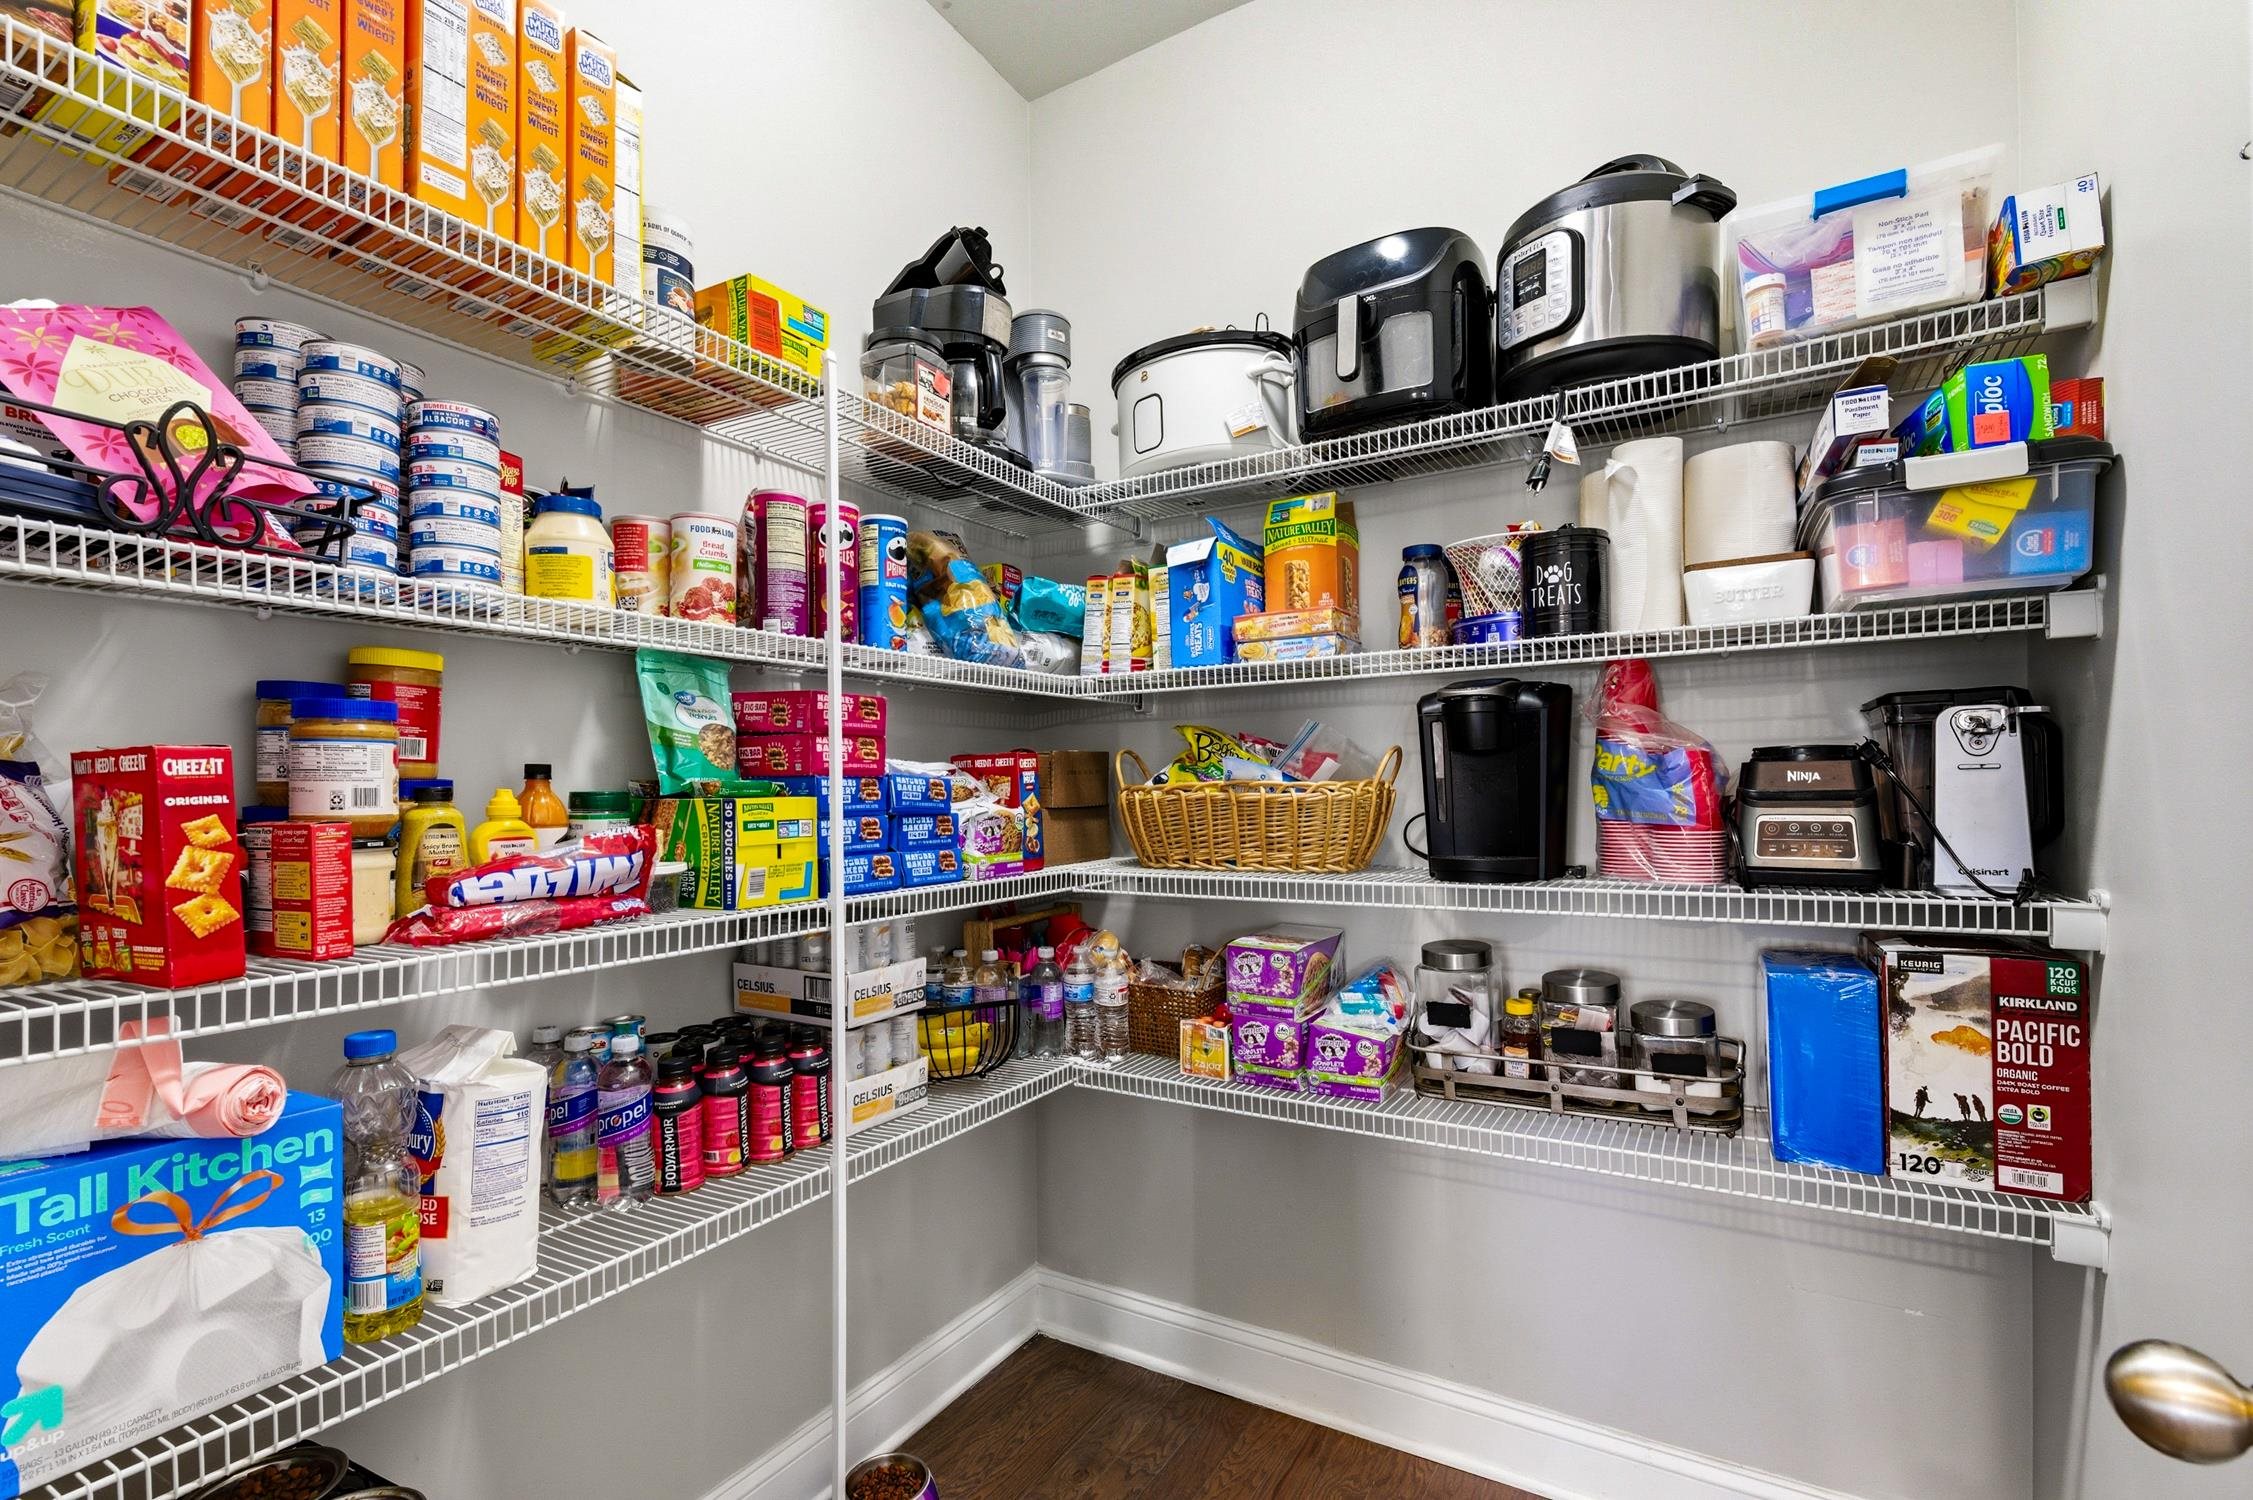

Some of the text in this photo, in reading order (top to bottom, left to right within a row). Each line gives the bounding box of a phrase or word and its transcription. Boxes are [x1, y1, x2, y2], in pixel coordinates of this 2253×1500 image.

[528, 16, 559, 40] Mini
[581, 54, 609, 75] Mini
[2078, 180, 2087, 192] 40
[1841, 398, 1858, 406] FOOD
[424, 415, 470, 428] ALBACORE
[504, 474, 518, 487] Top
[690, 525, 711, 533] FOOD
[1266, 519, 1334, 544] NATURE VALLEY
[703, 540, 724, 550] Bread
[1222, 549, 1235, 567] 40
[1531, 583, 1582, 608] TREATS
[1712, 583, 1786, 605] BUTTER
[1787, 769, 1821, 782] NINJA
[902, 823, 934, 832] BAKERY
[725, 802, 733, 881] 30 POUCHES
[701, 823, 709, 882] CRUNCHY
[706, 803, 720, 904] NATURE VALLEY
[1900, 959, 1940, 969] KEURIG
[2049, 967, 2077, 979] 120
[737, 978, 776, 994] CELSIUS
[854, 983, 892, 1001] CELSIUS
[2050, 986, 2077, 994] PODS
[1998, 996, 2078, 1012] KIRKLAND
[1996, 1019, 2080, 1047] PACIFIC
[1997, 1041, 2054, 1067] BOLD
[1996, 1067, 2038, 1081] ORGANIC
[853, 1084, 893, 1106] CELSIUS
[1996, 1086, 2041, 1096] EXTRA BOLD
[2041, 1084, 2070, 1092] COFFEE
[598, 1099, 647, 1136] propel
[664, 1118, 677, 1187] BODYARMOR
[1900, 1153, 1941, 1175] 120
[0, 1127, 334, 1236] Tall Kitchen
[308, 1207, 325, 1224] 13
[0, 1223, 91, 1257] Fresh Scent
[310, 1228, 332, 1244] 00
[28, 1250, 53, 1262] strong
[53, 1247, 68, 1255] and
[97, 1235, 107, 1243] for
[24, 1261, 39, 1269] and
[65, 1434, 98, 1453] GALLON
[125, 1408, 163, 1428] CAPACITY
